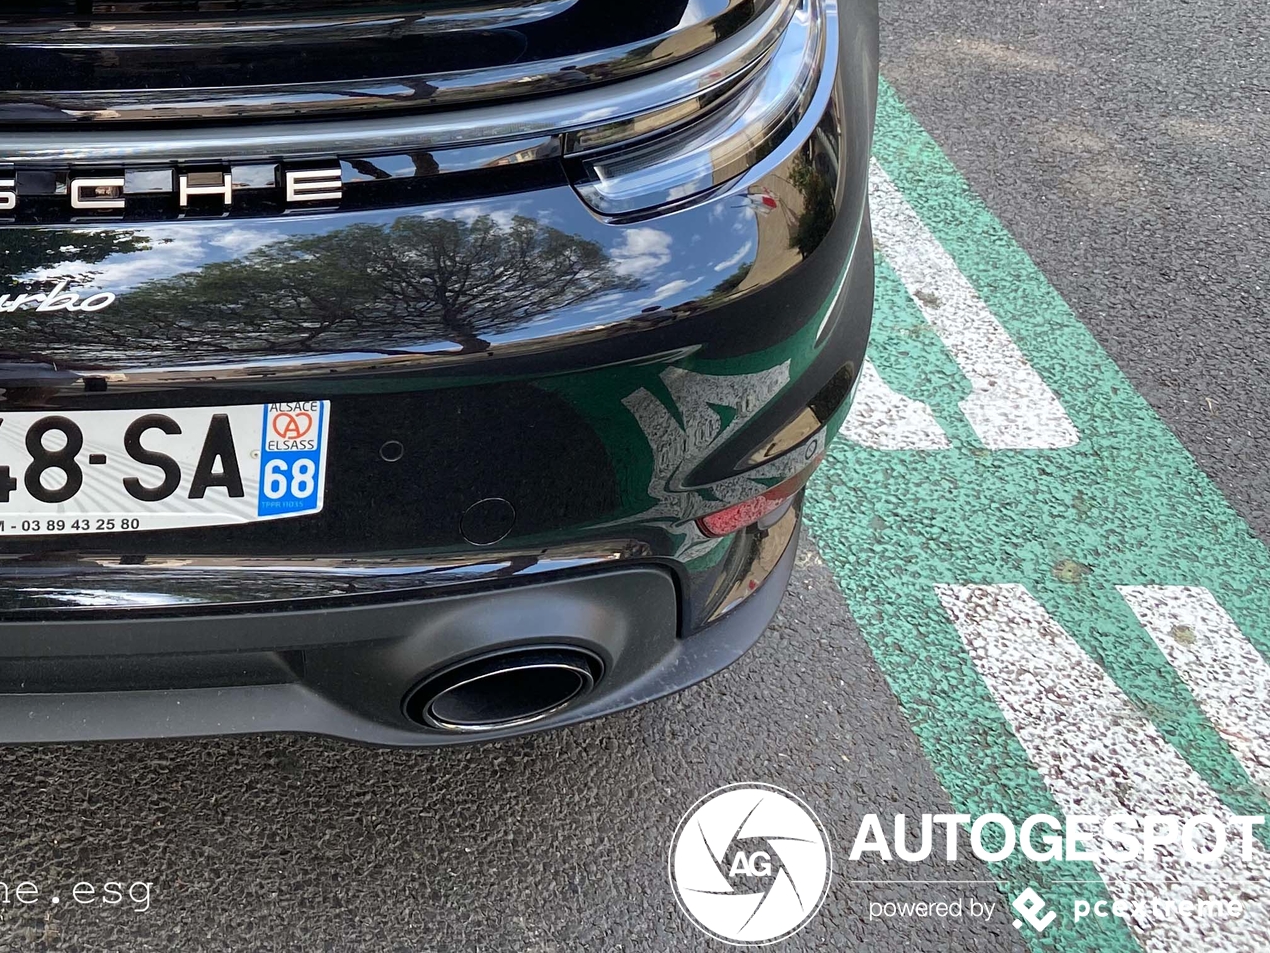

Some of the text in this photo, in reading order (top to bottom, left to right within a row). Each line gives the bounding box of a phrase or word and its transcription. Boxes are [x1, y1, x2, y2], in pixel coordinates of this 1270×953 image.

[269, 401, 318, 413] ALSACE
[267, 439, 315, 451] ELSASS
[263, 458, 316, 499] 68
[21, 519, 41, 532] 03
[46, 519, 66, 531] 89
[71, 519, 91, 531] 43
[95, 518, 115, 531] 25
[120, 518, 140, 530] 80
